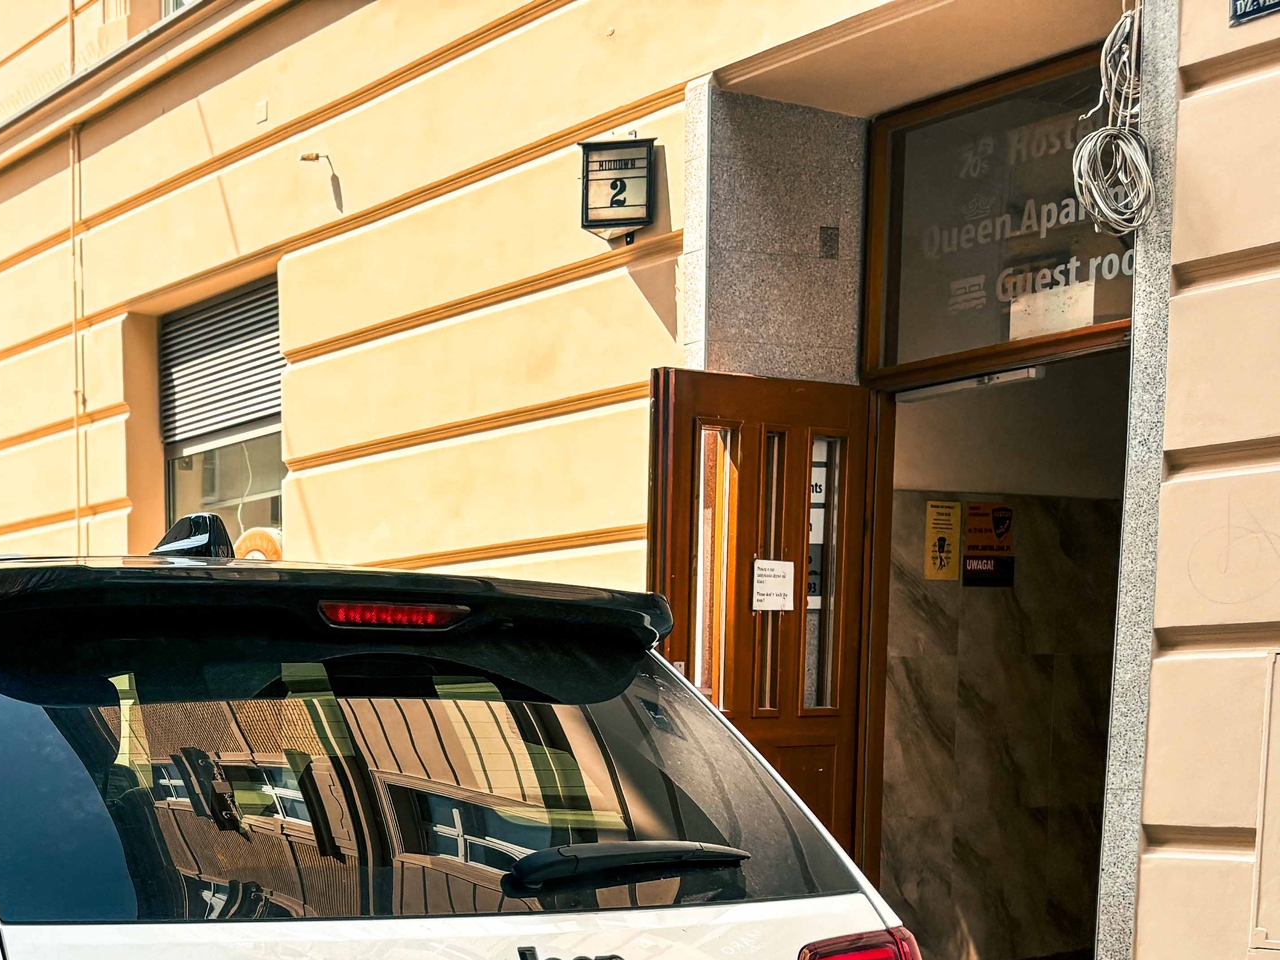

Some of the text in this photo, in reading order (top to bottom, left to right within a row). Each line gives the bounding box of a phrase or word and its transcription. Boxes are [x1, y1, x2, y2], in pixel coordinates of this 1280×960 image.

[610, 178, 627, 207] 2
[924, 213, 1011, 259] Queen
[996, 255, 1081, 303] Guest
[966, 559, 994, 570] UWAGA!
